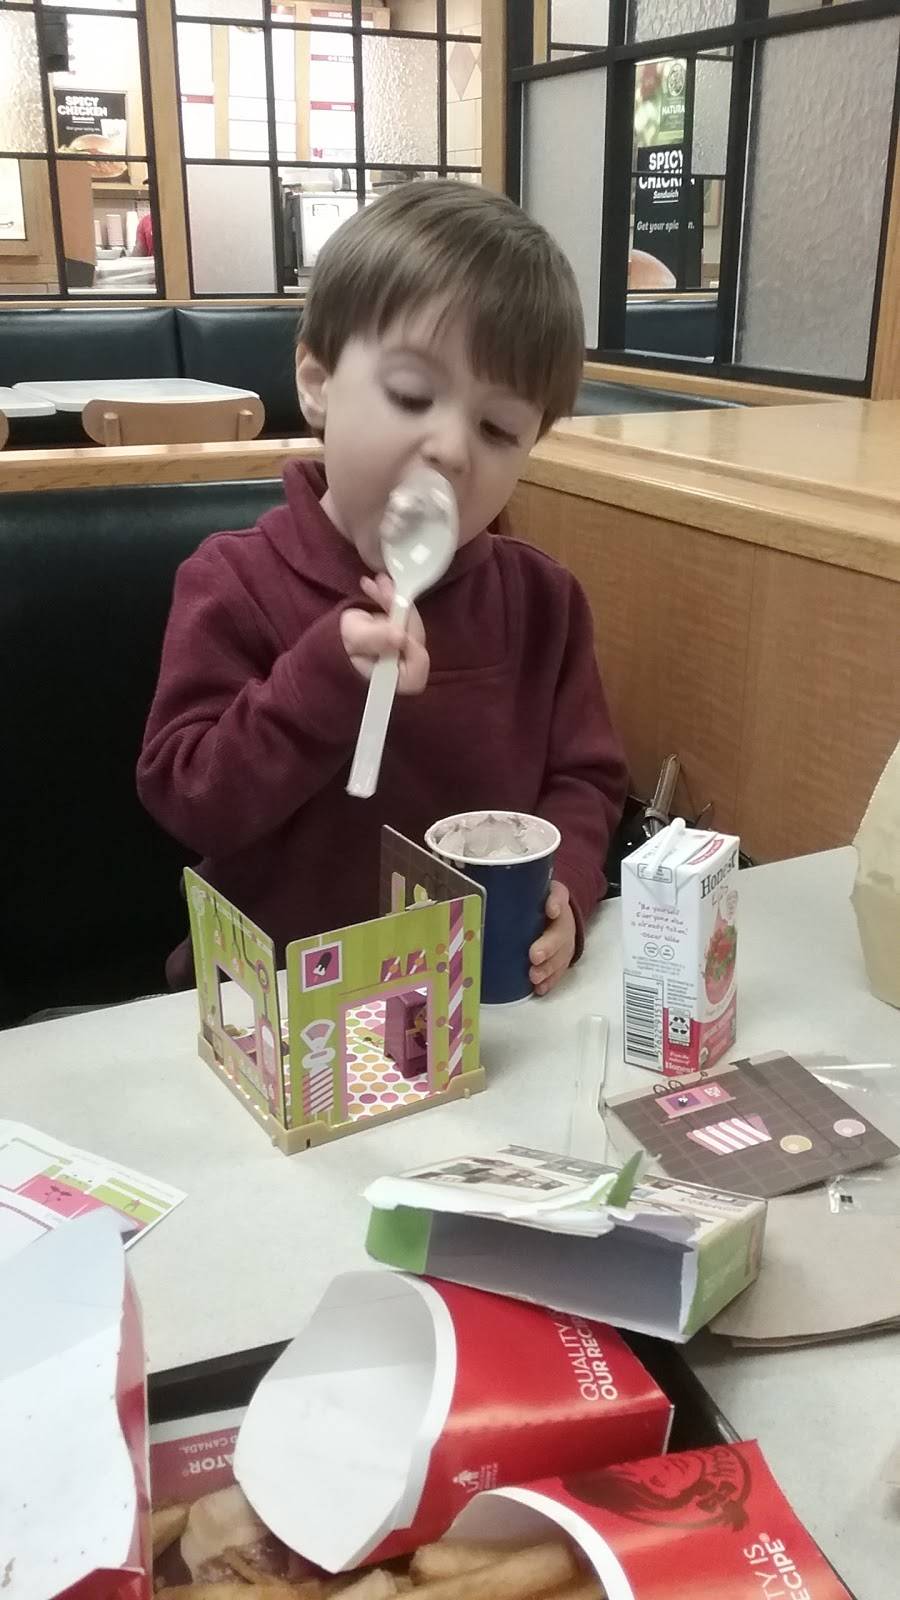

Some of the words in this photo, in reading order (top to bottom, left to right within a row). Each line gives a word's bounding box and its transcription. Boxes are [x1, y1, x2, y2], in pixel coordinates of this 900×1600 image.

[57, 105, 108, 117] CHICKEN
[65, 96, 99, 107] SPICY
[636, 220, 649, 231] Get
[649, 221, 665, 234] your
[665, 220, 680, 233] spic
[700, 848, 738, 900] Honest
[554, 1322, 600, 1401] QUALITY
[592, 1360, 619, 1400] OUR
[743, 1544, 769, 1565] IS
